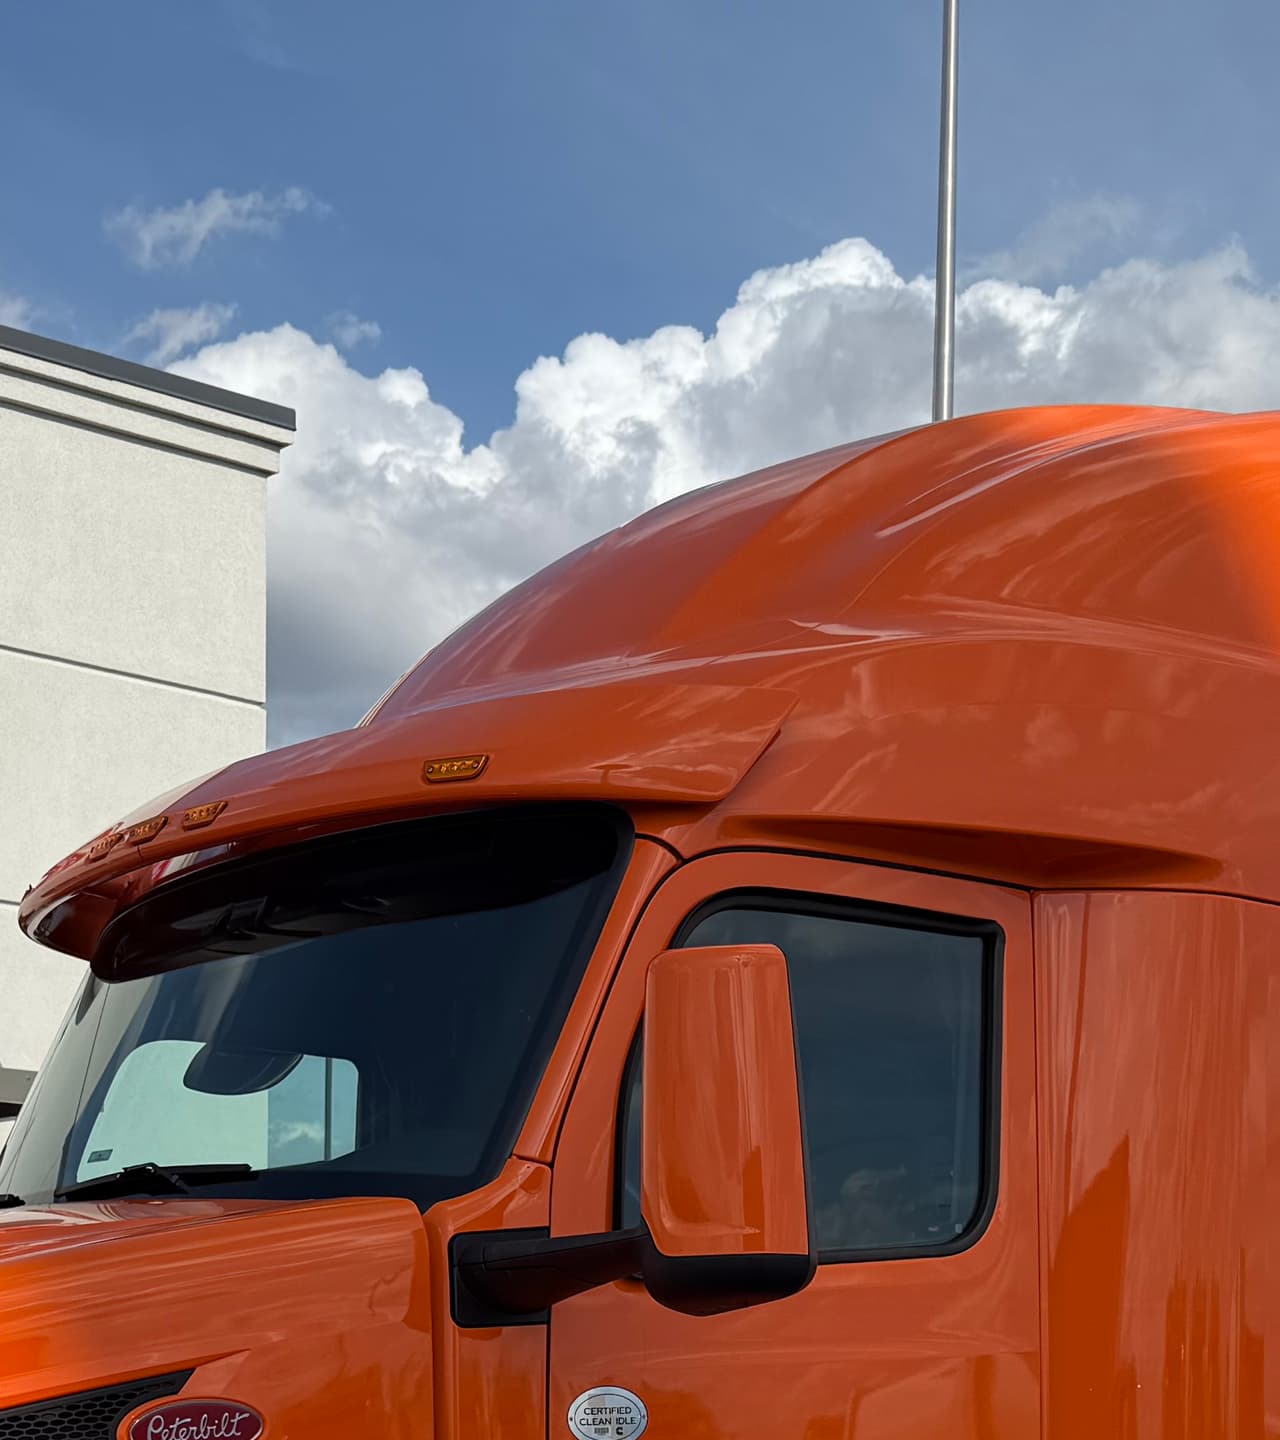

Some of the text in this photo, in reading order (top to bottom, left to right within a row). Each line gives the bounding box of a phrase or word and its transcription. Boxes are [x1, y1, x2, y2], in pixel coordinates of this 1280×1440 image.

[583, 1406, 632, 1415] CERTIFIED
[579, 1416, 637, 1426] CLEAN IDLE
